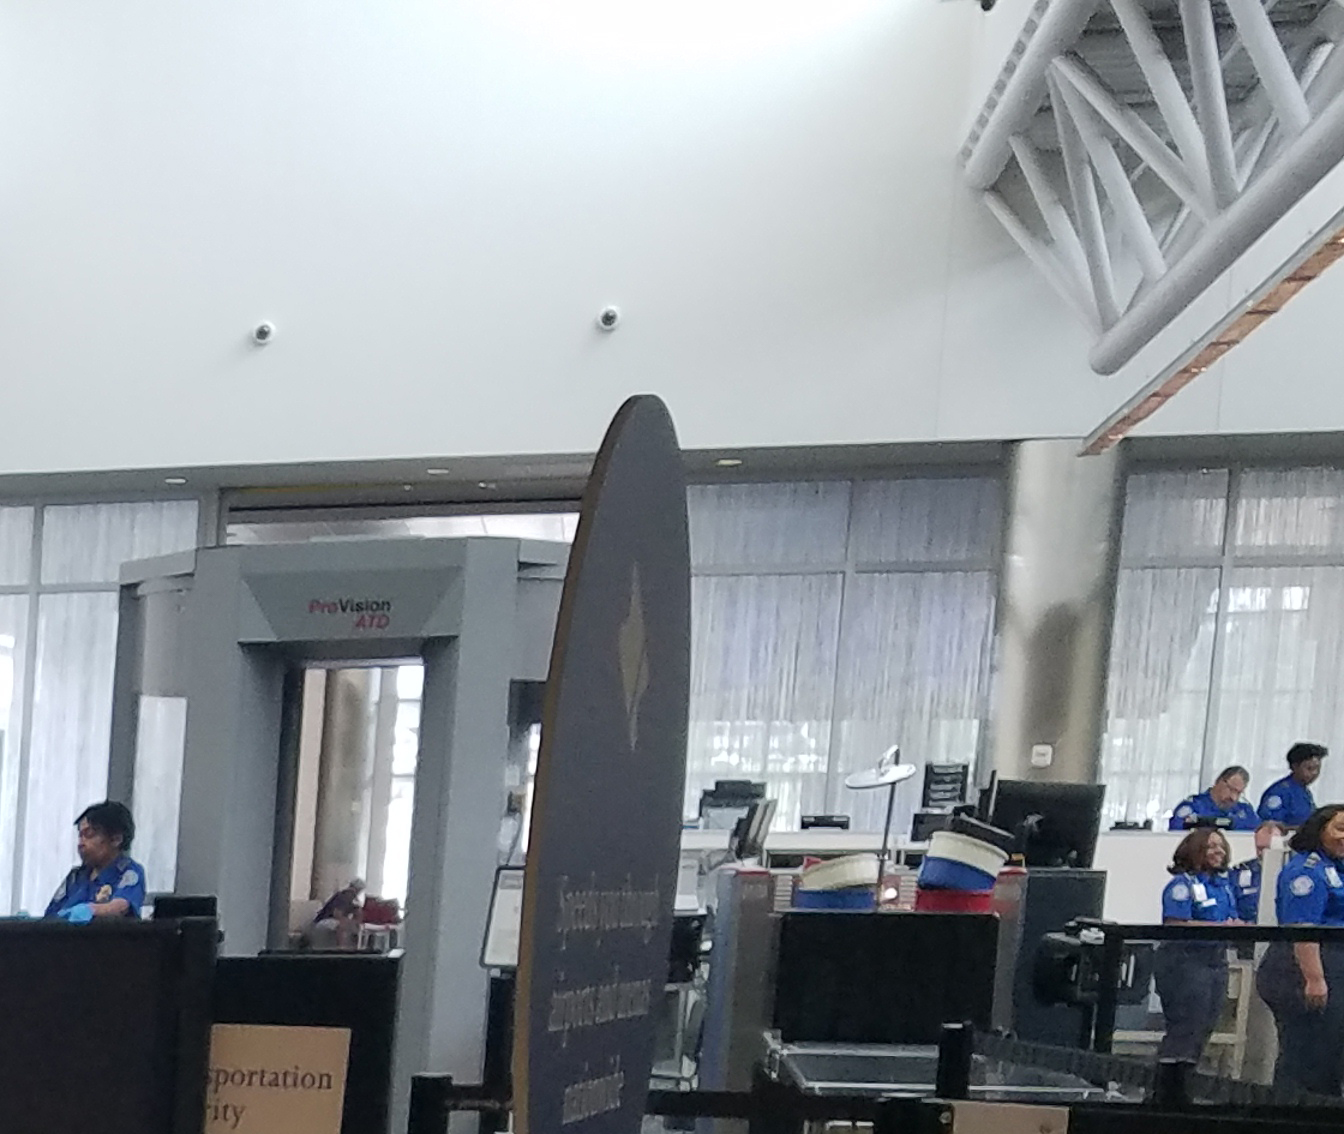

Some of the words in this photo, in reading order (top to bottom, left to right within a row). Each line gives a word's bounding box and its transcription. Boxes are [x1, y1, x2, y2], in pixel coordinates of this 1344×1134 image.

[308, 598, 391, 613] ProVision
[355, 614, 390, 629] ATD
[214, 1065, 332, 1093] portation
